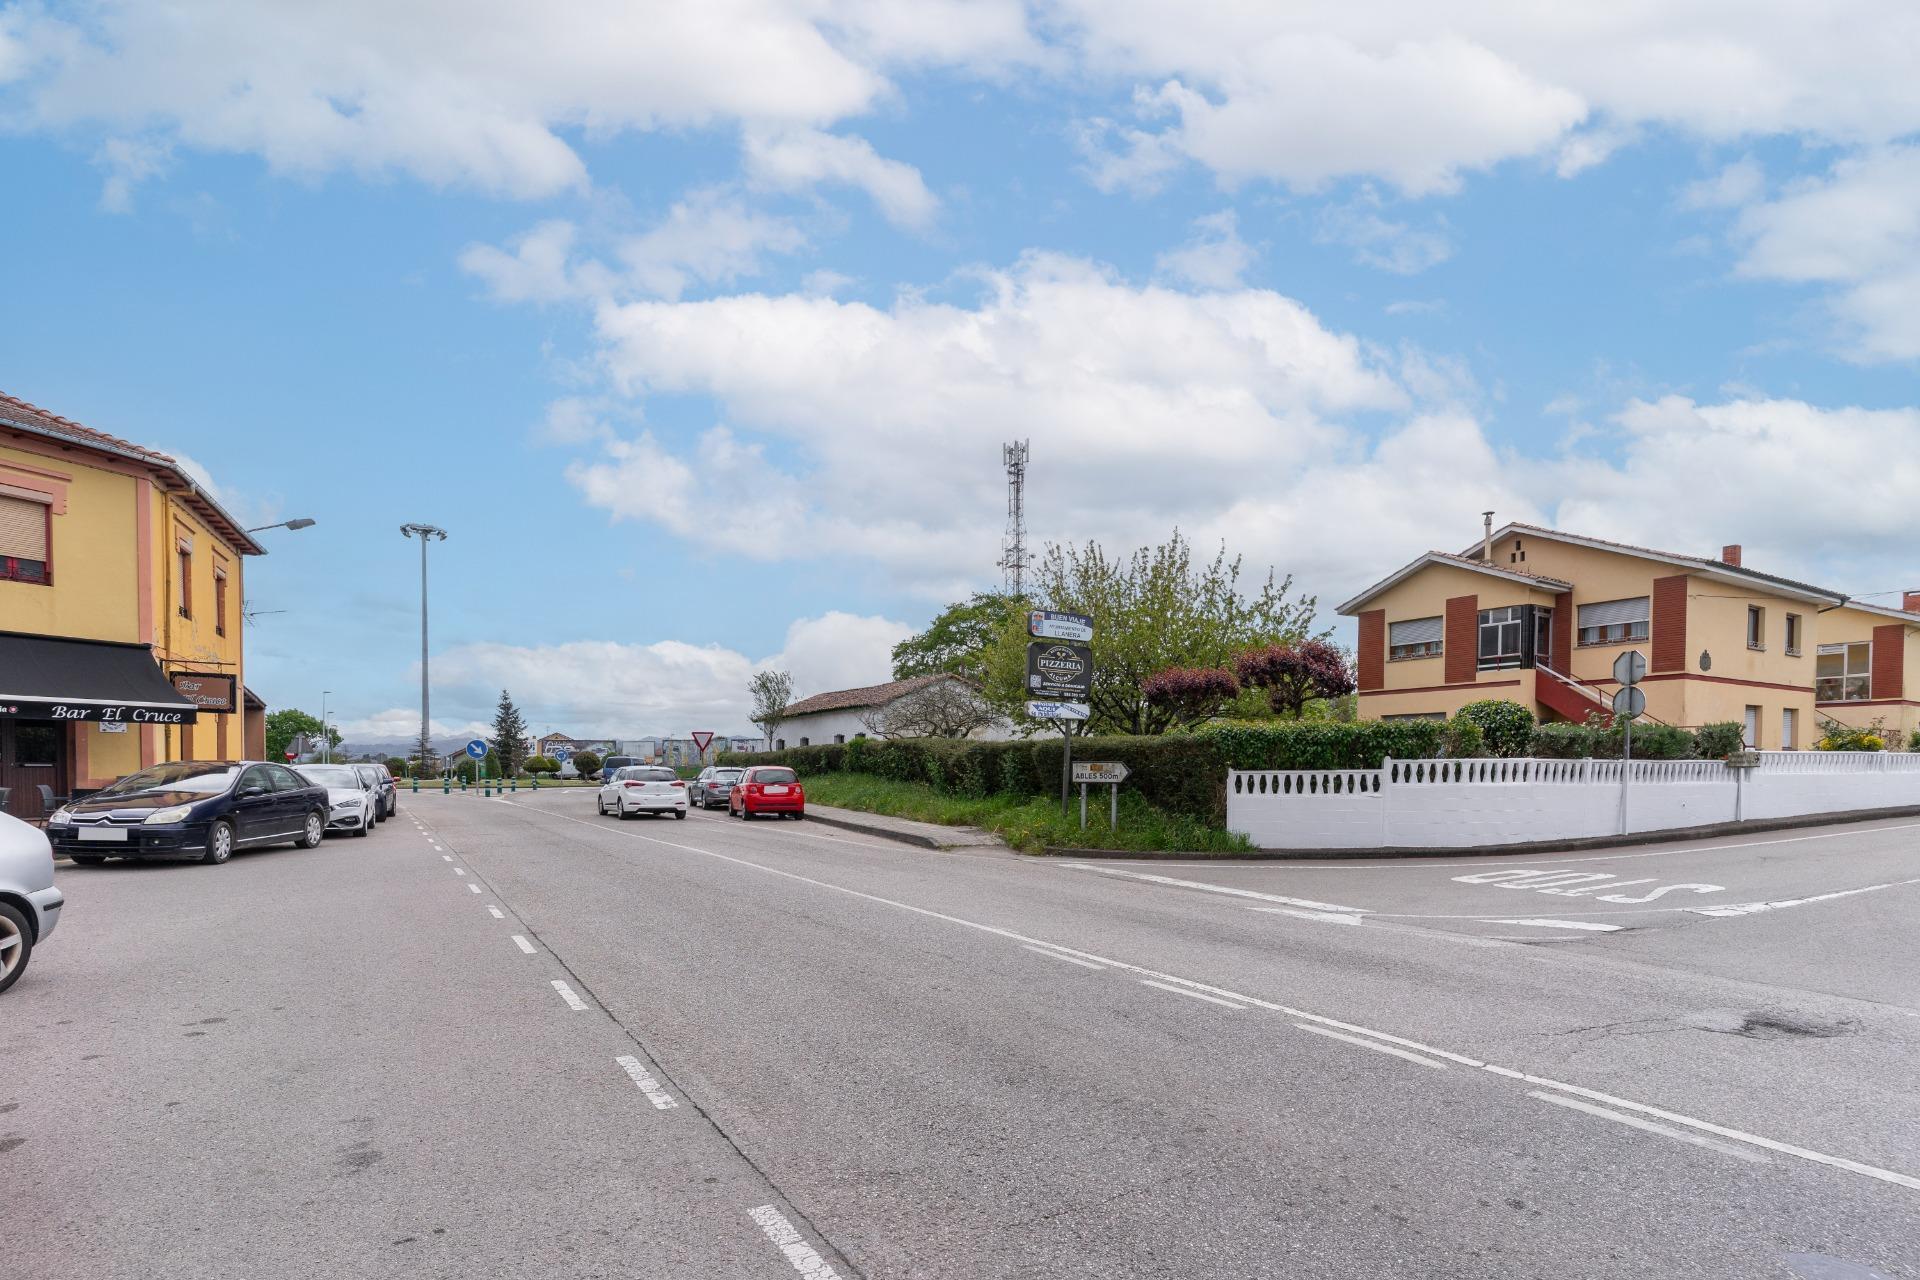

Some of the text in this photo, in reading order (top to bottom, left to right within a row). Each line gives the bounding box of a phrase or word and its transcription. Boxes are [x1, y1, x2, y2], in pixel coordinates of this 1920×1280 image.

[1050, 613, 1086, 626] BUEN VIAJE
[1054, 630, 1081, 639] LLANERA
[1040, 659, 1082, 670] PIZZERIA
[179, 680, 202, 691] Bar
[196, 694, 227, 705] Cruce
[51, 705, 182, 722] Bar El Cruce
